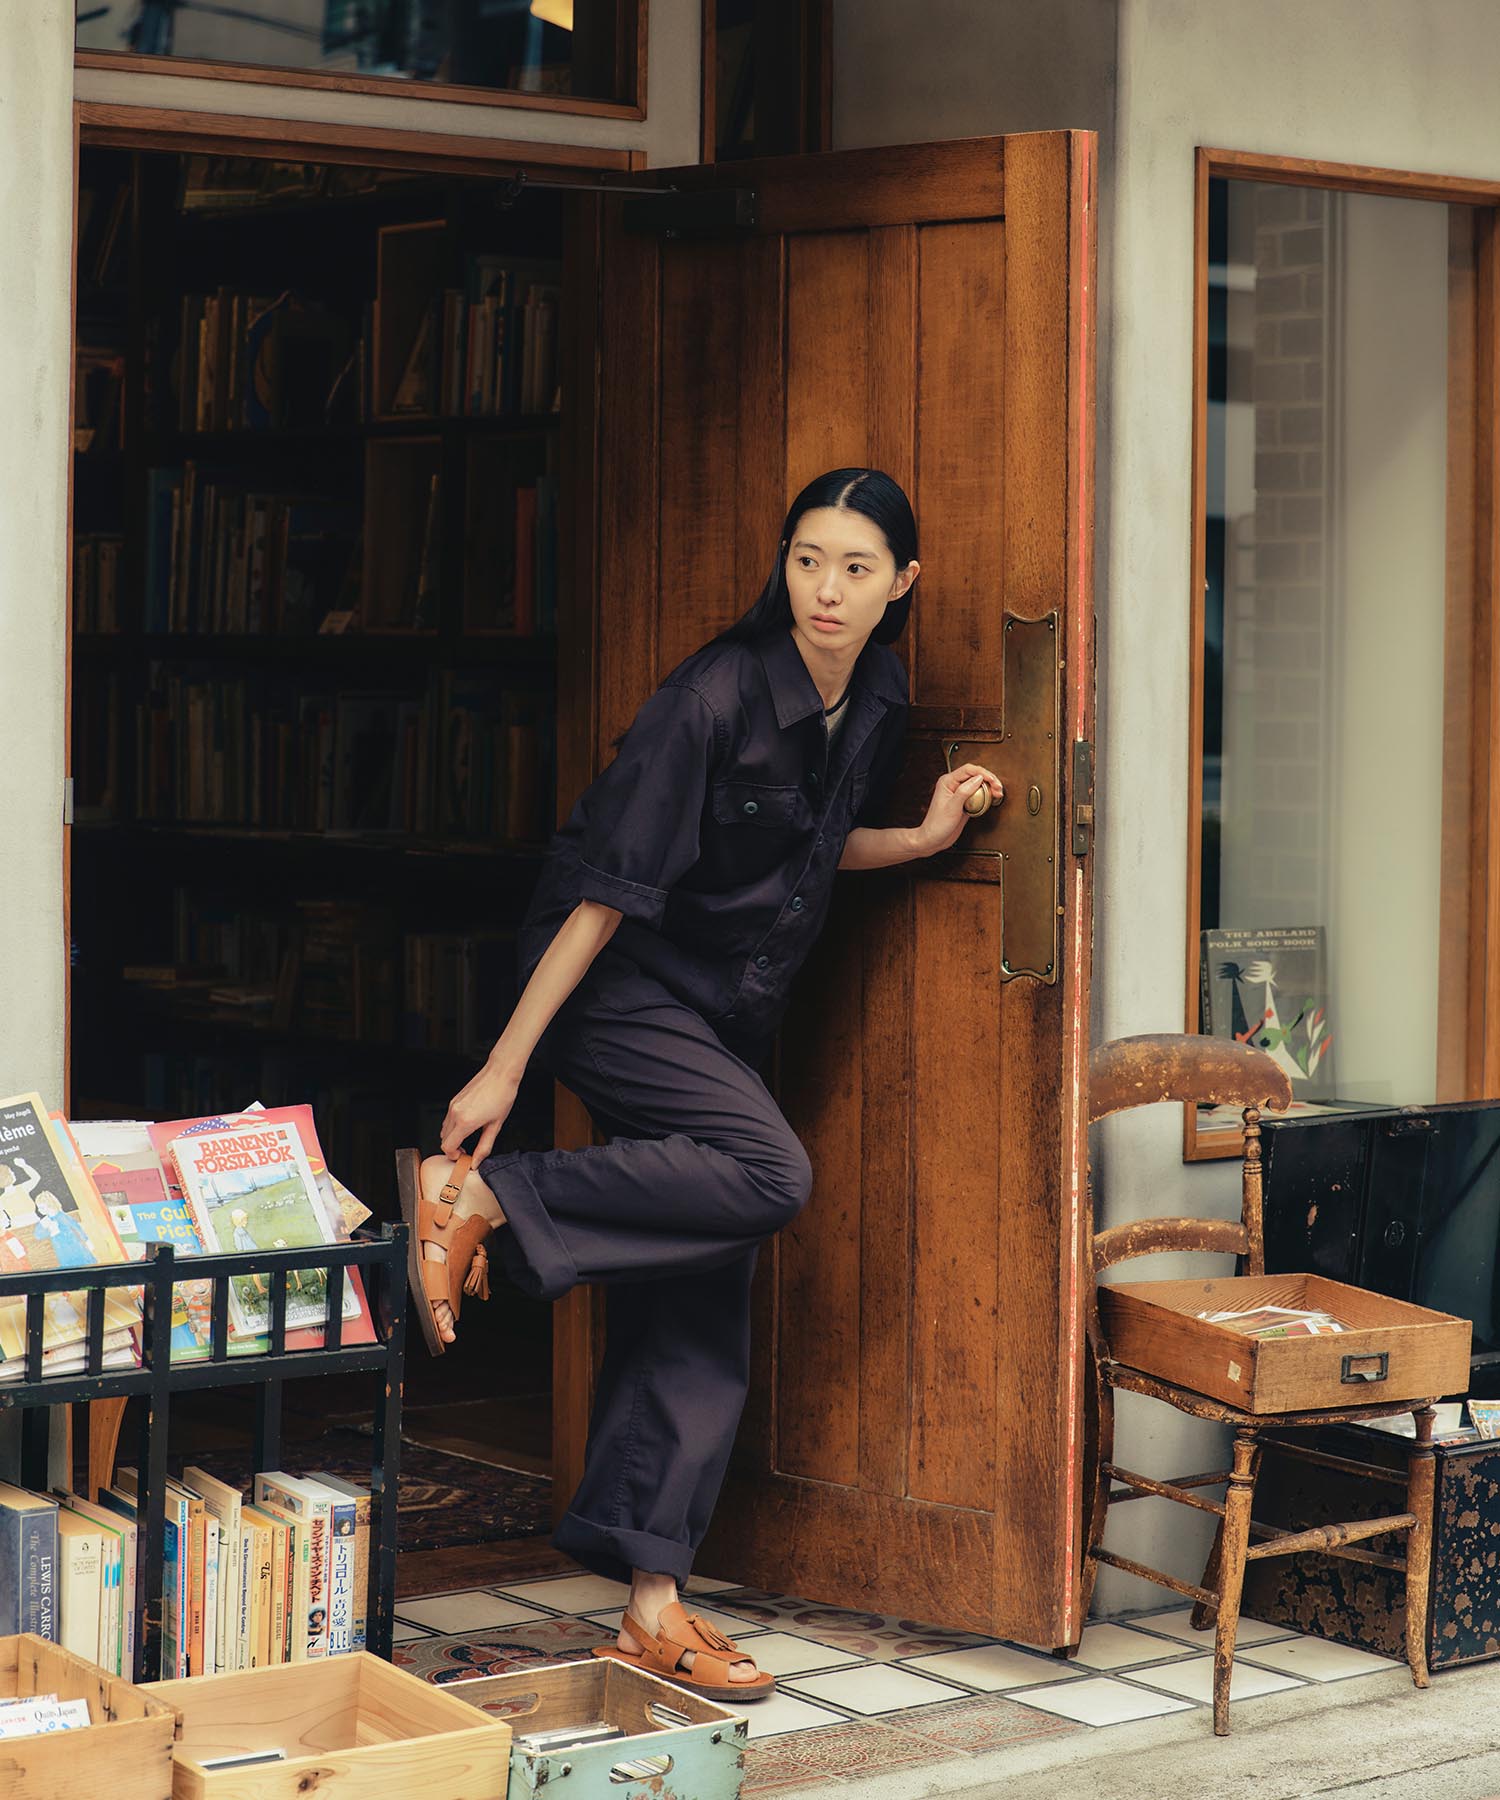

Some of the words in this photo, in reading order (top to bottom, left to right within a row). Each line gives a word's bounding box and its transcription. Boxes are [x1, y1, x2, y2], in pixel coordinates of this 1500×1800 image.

[1224, 931, 1251, 939] THE
[1256, 929, 1316, 938] ABELARD
[1208, 941, 1242, 949] FOLK
[1247, 940, 1279, 948] SONG
[0, 1124, 36, 1142] lème
[198, 1131, 279, 1158] BARNENS
[256, 1145, 295, 1167] BOK
[160, 1204, 191, 1222] Gul
[156, 1223, 198, 1241] Picn
[40, 1556, 51, 1595] LEWIS
[260, 1561, 270, 1580] Us
[334, 1544, 348, 1595] トリコロール
[29, 1600, 41, 1633] Illustra
[40, 1596, 51, 1641] CARRO
